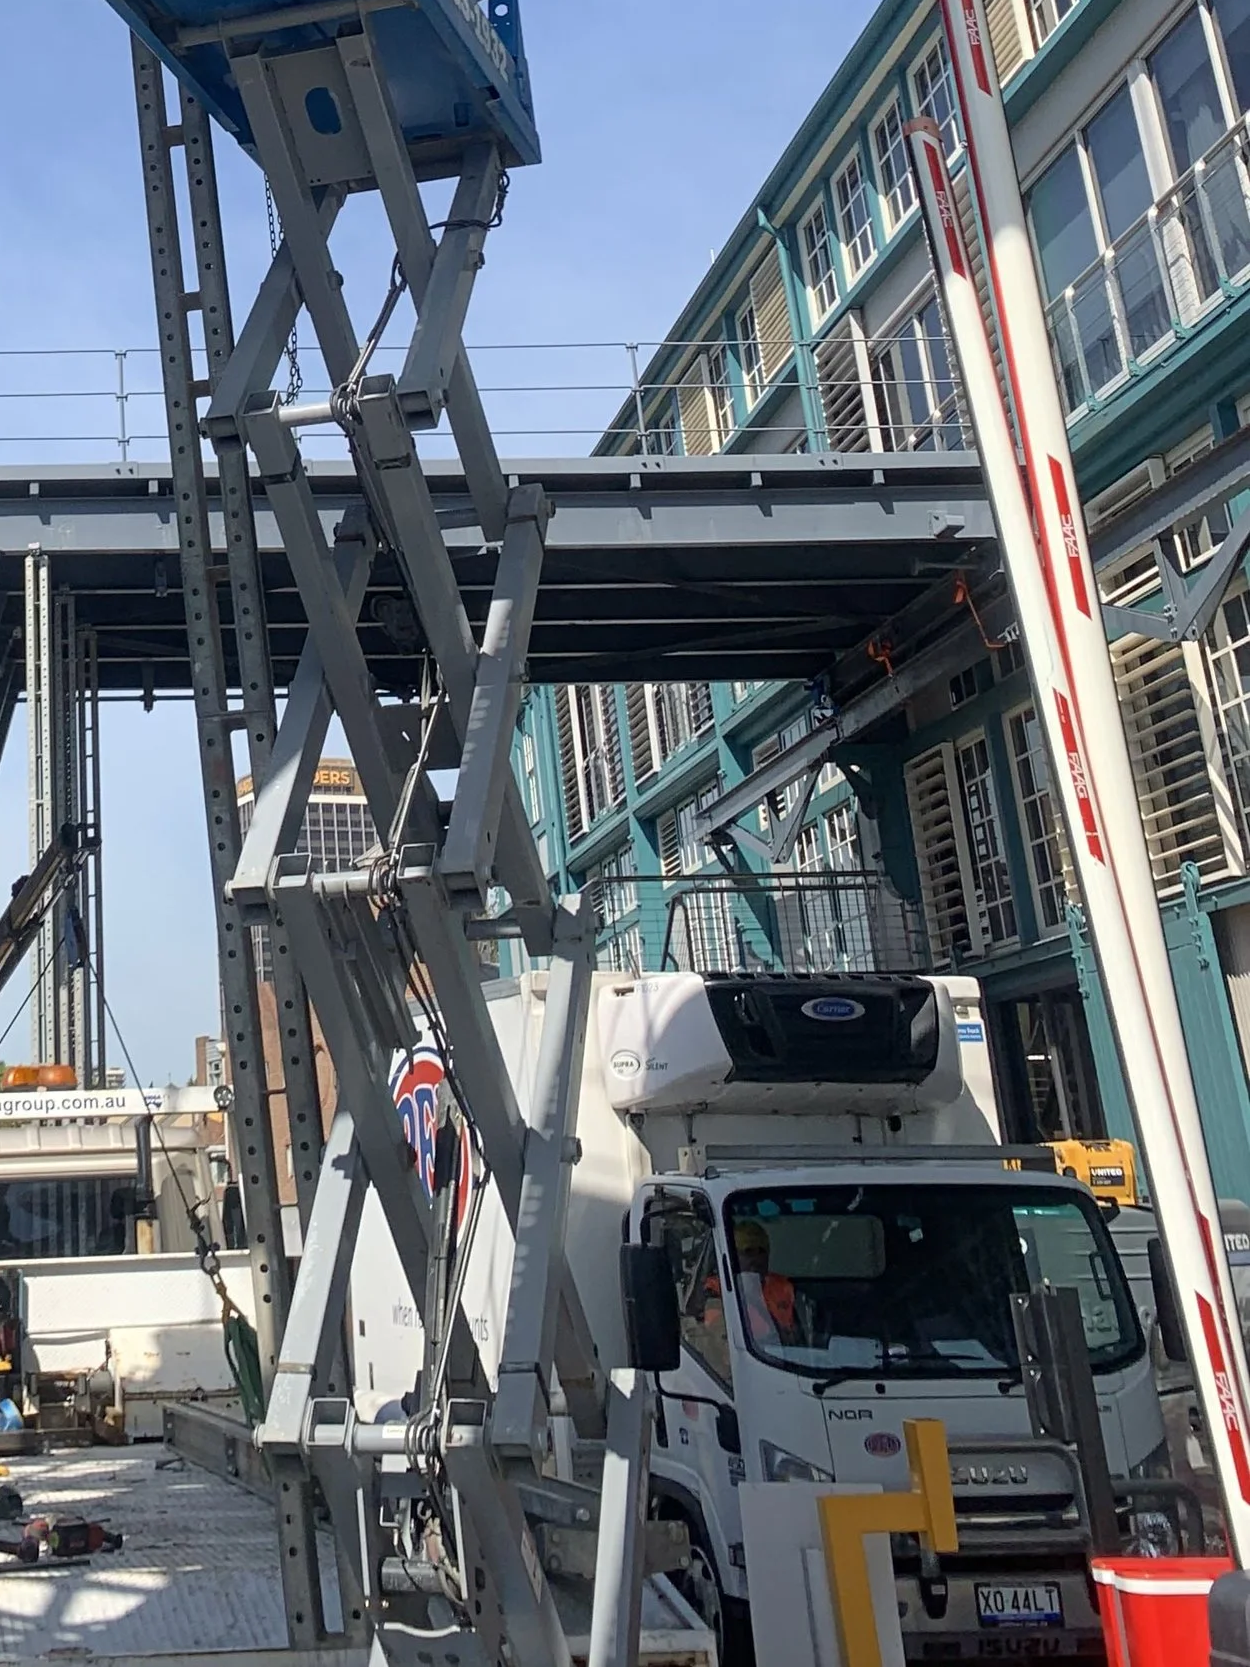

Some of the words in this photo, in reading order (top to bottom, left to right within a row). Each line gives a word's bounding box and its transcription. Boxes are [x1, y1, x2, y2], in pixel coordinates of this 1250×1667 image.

[965, 9, 981, 45] FAAC
[1061, 514, 1079, 558] FAAC
[816, 1001, 852, 1013] Carrier
[1091, 1167, 1123, 1176] UNITED
[1224, 1233, 1250, 1252] ITED
[1215, 1371, 1239, 1431] FAAC
[828, 1409, 873, 1420] NQR
[951, 1465, 1028, 1484] SUZU
[978, 1637, 1060, 1656] ISUZU
